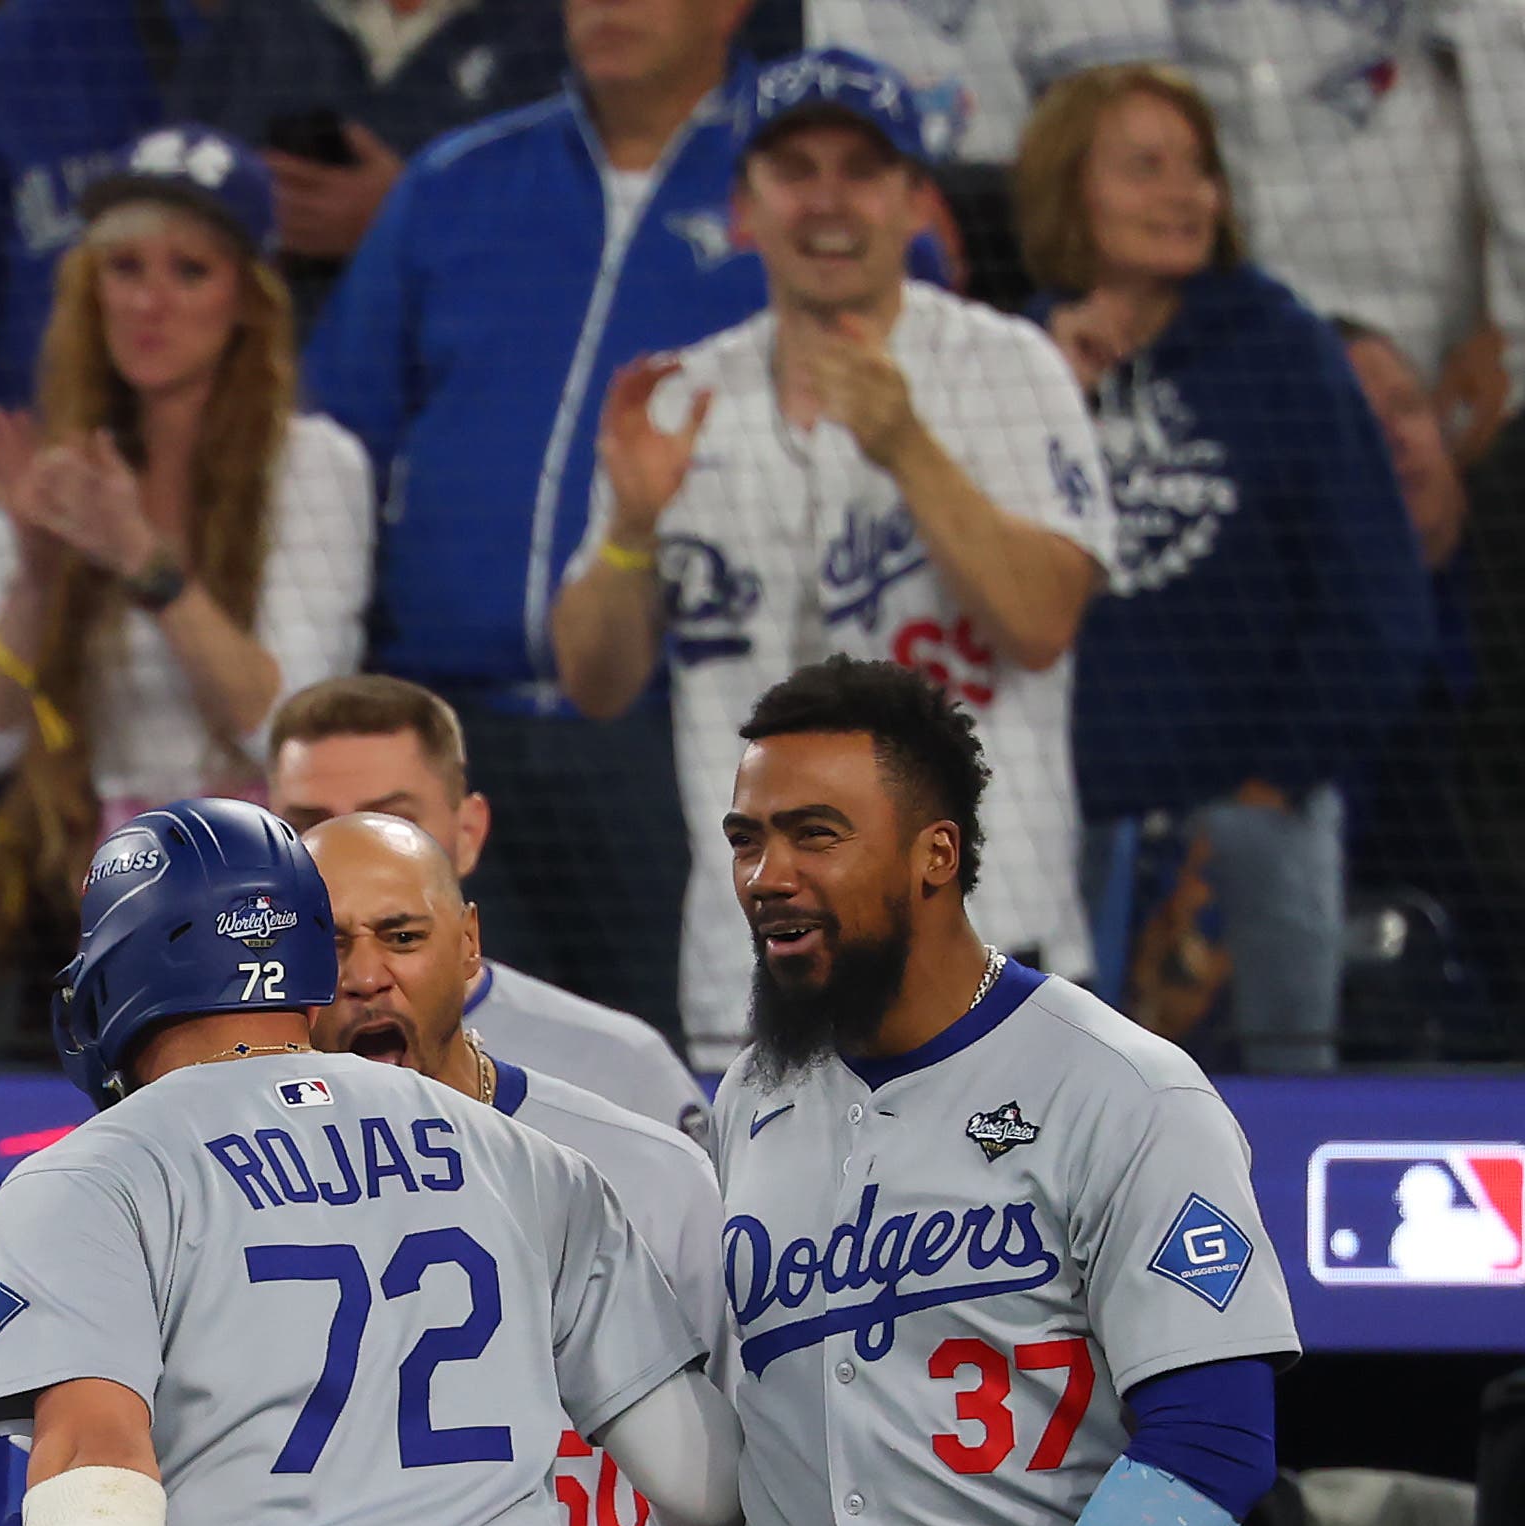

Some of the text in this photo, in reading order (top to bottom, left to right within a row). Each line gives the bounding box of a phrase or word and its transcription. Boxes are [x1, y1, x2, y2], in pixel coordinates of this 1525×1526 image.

[89, 849, 161, 886] STRAUSS
[238, 961, 286, 1001] 72
[204, 1116, 465, 1210] ROJAS
[1180, 1263, 1240, 1279] GUGGENHEIM
[1182, 1224, 1227, 1264] G
[722, 1182, 1060, 1382] Dodgers
[244, 1226, 515, 1474] 72
[928, 1338, 1096, 1475] 37
